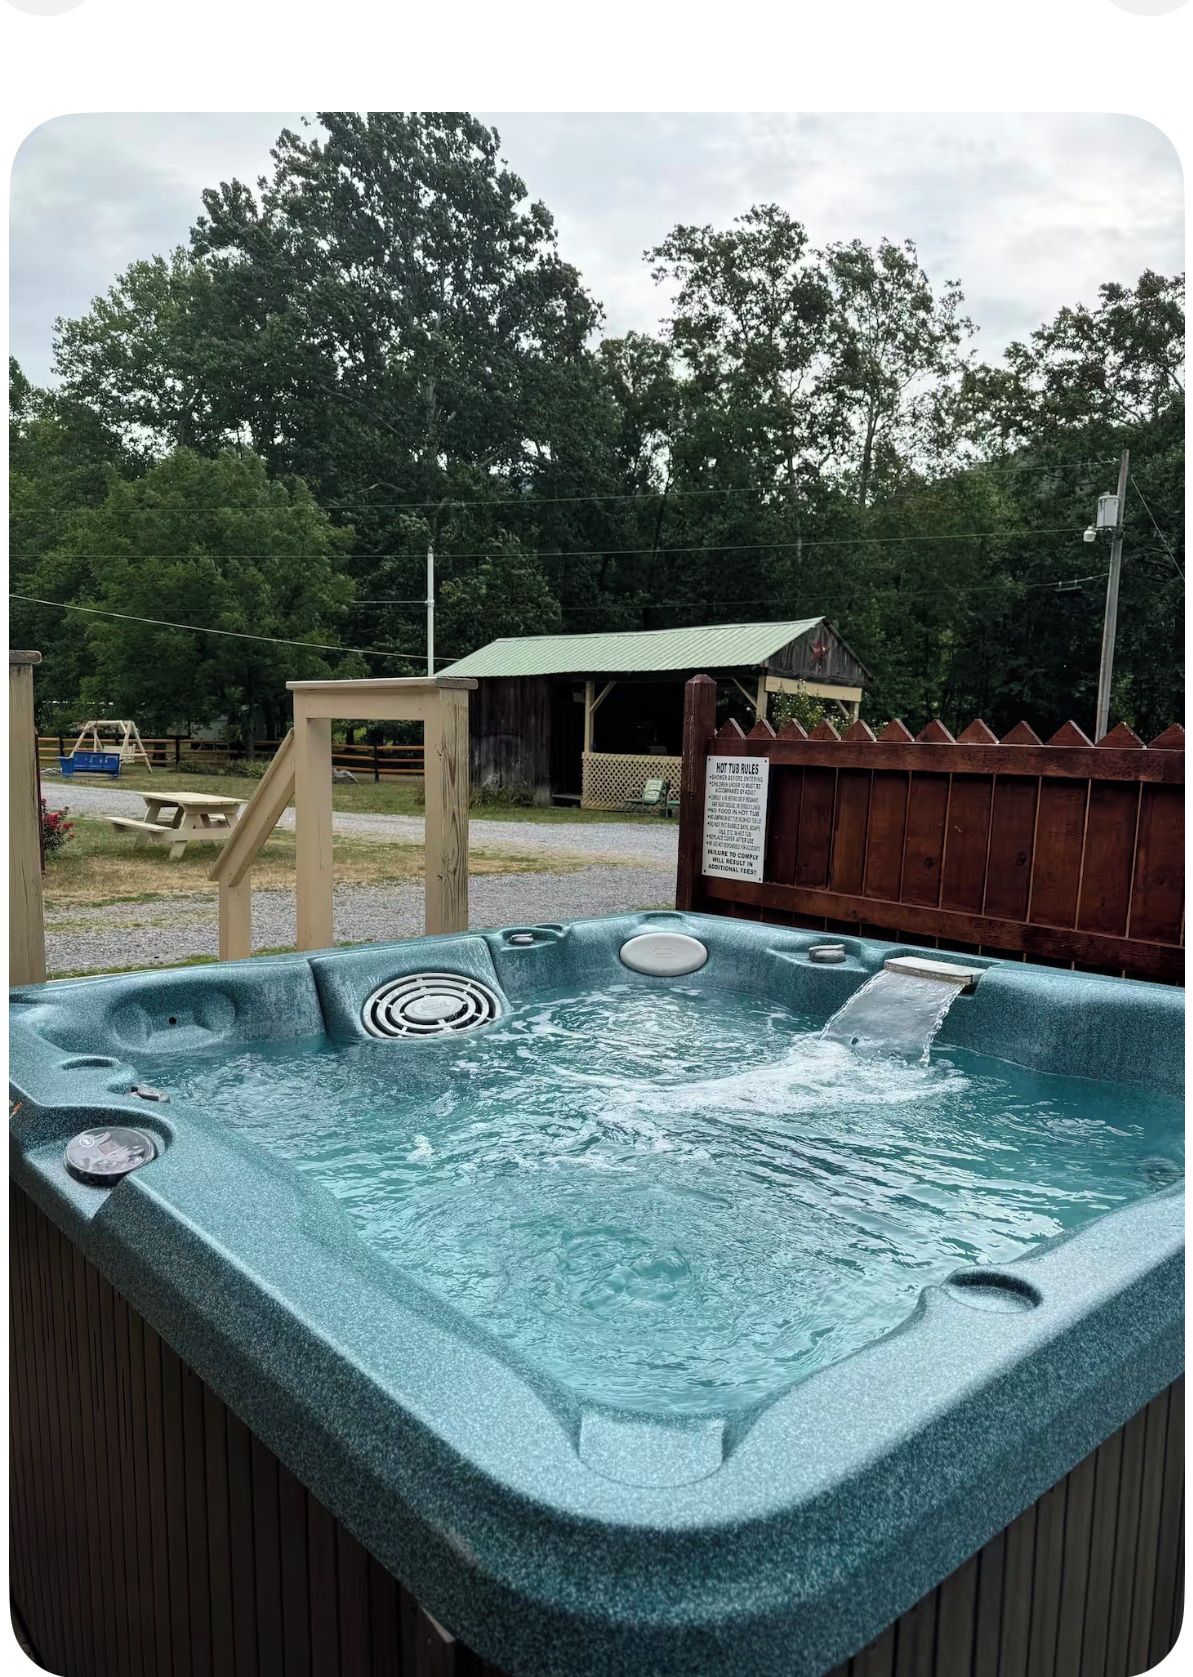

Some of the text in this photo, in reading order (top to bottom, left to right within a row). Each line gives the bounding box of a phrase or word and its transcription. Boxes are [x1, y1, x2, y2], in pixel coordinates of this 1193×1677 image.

[716, 763, 758, 774] HOT TUB RULES
[708, 864, 739, 873] ADDITIONAL
